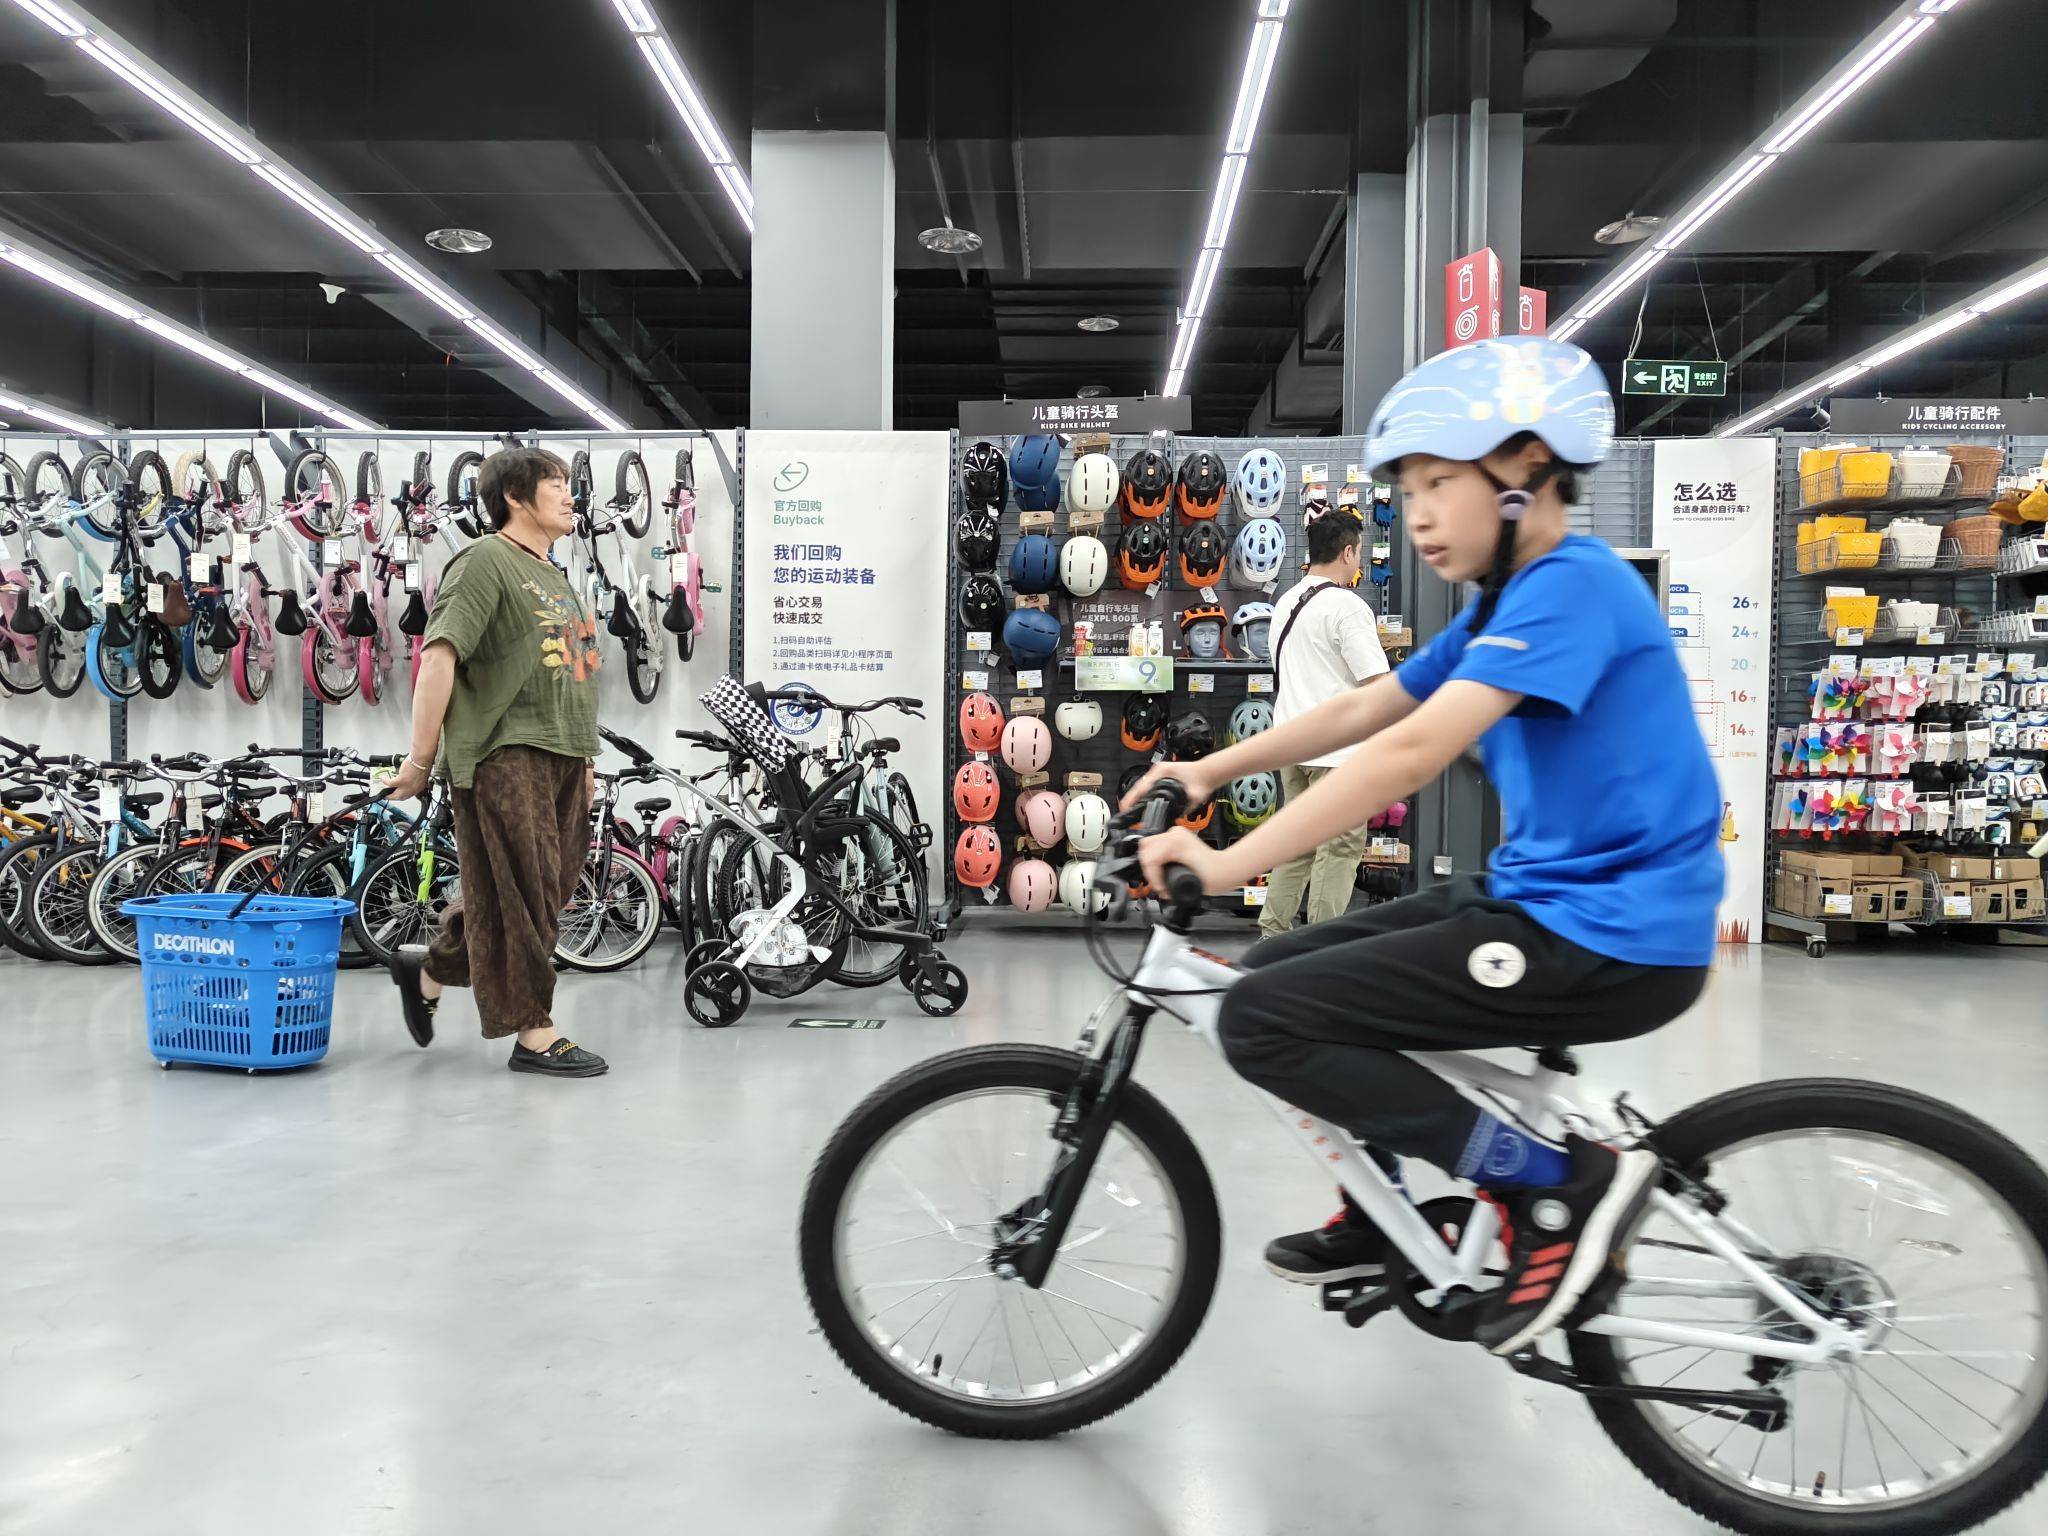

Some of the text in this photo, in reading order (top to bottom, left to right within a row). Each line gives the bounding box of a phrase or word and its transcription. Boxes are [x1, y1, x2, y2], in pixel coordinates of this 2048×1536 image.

[1032, 405, 1118, 420] 儿童骑行头盔
[1908, 406, 2001, 420] 儿童骑行配件
[1673, 482, 1737, 501] 怎么选
[774, 500, 822, 512] 官方回购
[774, 515, 824, 526] Buyback
[774, 544, 842, 561] 我们回购
[774, 567, 876, 585] 您的运动装备
[773, 596, 823, 608] 省心交易
[1732, 596, 1750, 608] 26
[773, 612, 823, 625] 快速成交
[1731, 626, 1750, 638] 24
[773, 636, 832, 645] 1.扫码自助评估
[1731, 658, 1748, 671] 20
[1139, 661, 1156, 684] 9
[1730, 690, 1748, 702] 16
[1730, 724, 1747, 736] 14
[154, 933, 234, 956] DECATHLON
